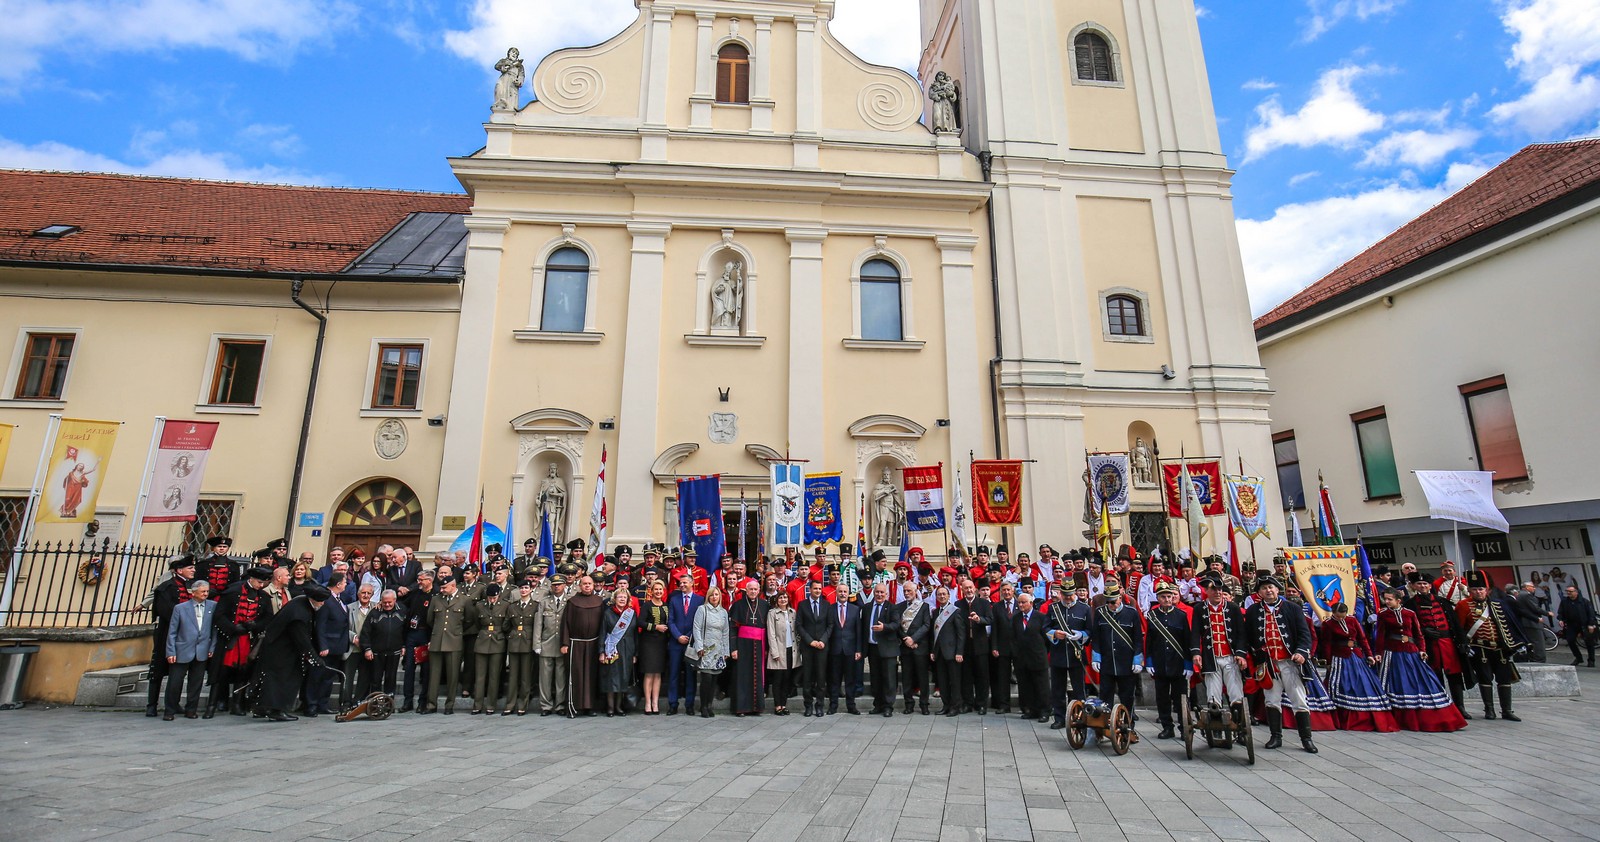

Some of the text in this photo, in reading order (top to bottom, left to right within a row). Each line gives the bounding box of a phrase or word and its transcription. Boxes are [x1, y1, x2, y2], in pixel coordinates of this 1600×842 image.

[1519, 536, 1571, 551] I YUKI
[1403, 545, 1443, 557] I YUKI
[1300, 563, 1349, 575] LIČKA PUKOVNIJA
